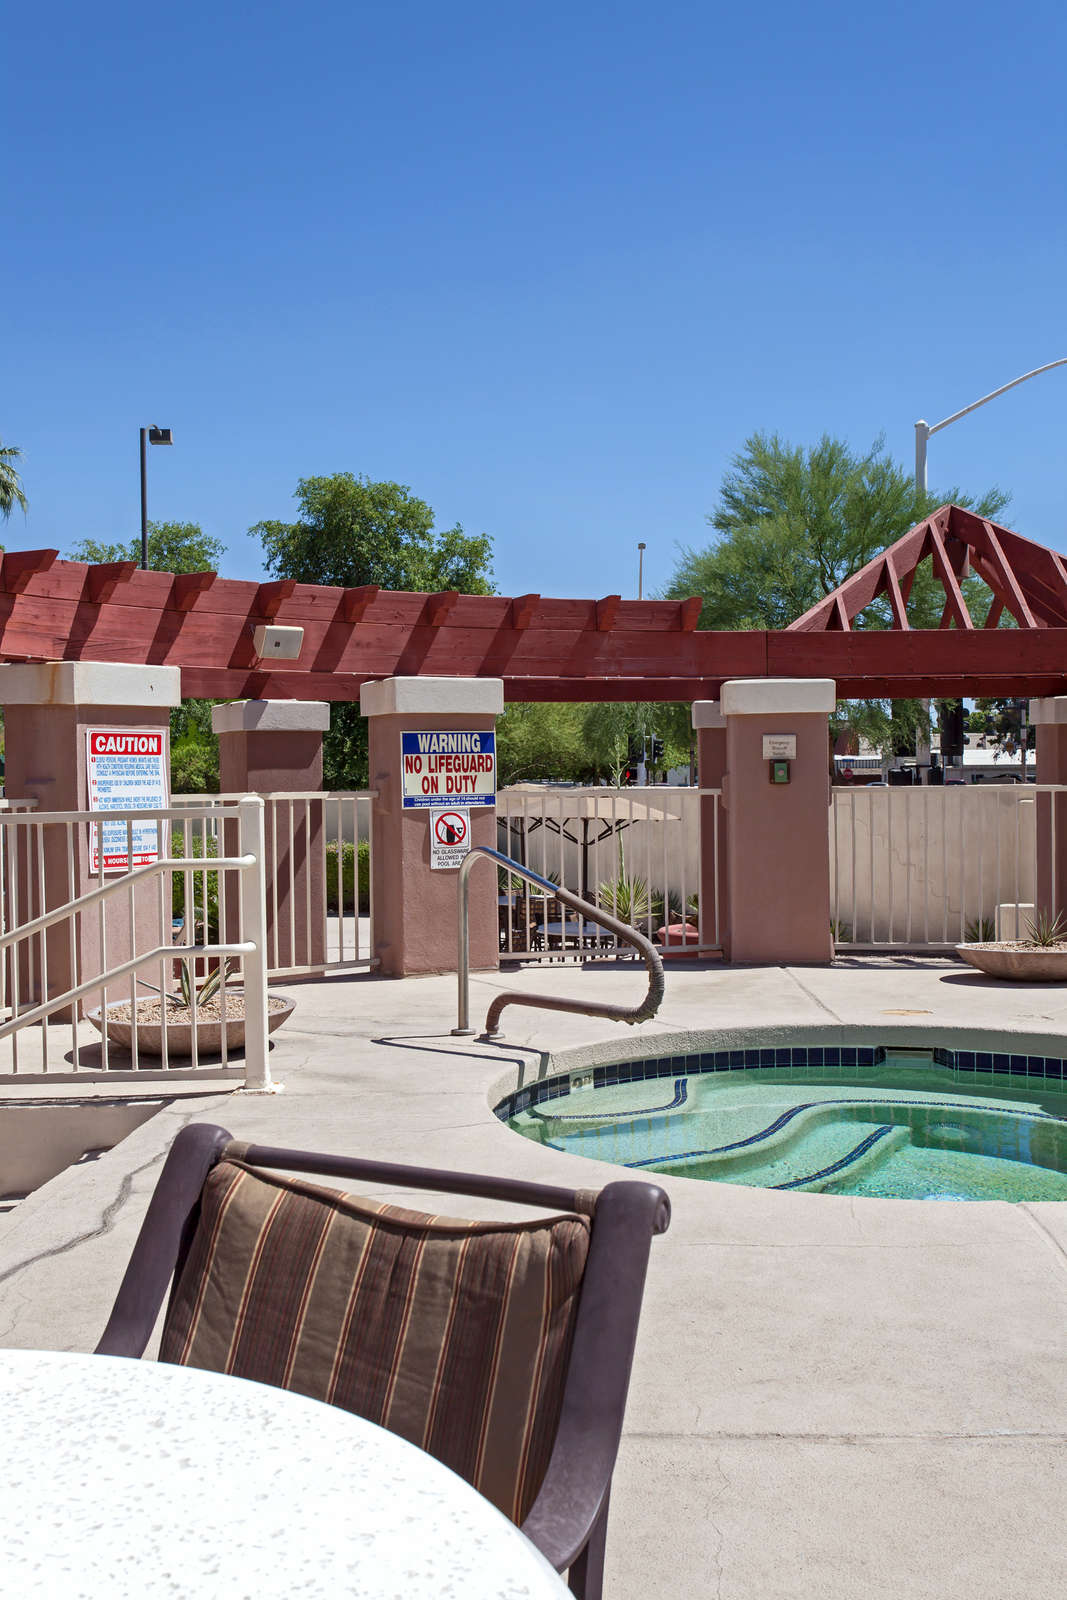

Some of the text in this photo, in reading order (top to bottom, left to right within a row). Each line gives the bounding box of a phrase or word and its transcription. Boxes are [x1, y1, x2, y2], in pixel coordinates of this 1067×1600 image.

[95, 735, 158, 753] CAUTION
[417, 733, 481, 753] WARNING
[405, 754, 493, 774] NO LIFEGUARD
[421, 775, 439, 794] ON
[446, 775, 478, 794] DUTY
